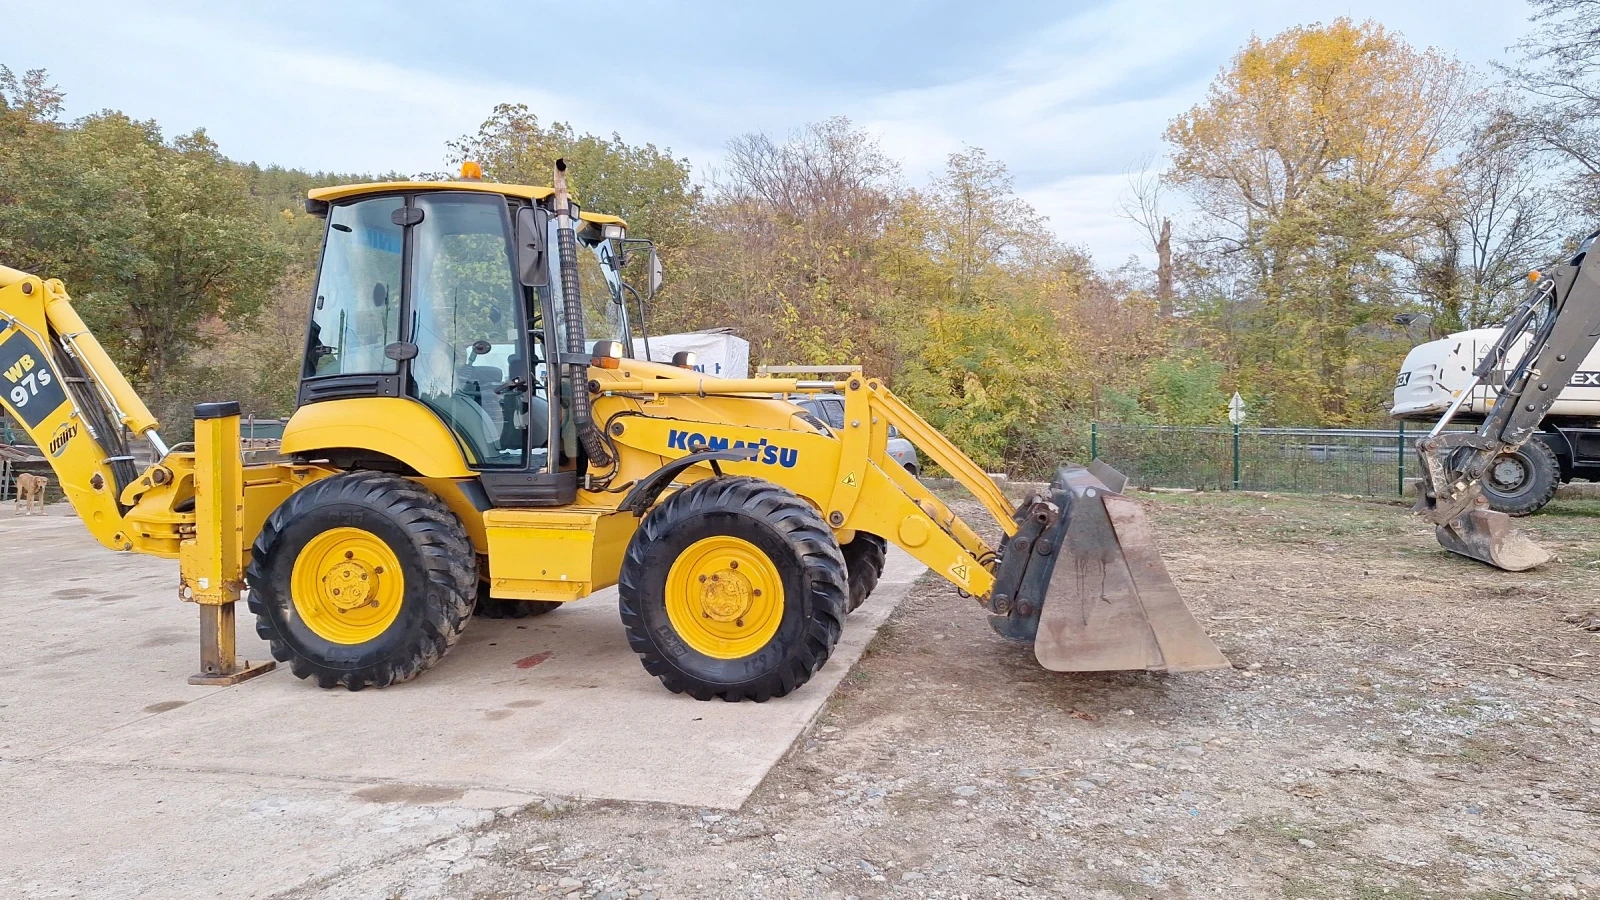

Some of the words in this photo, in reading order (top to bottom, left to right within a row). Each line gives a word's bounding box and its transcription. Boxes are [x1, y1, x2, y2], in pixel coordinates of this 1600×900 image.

[3, 354, 35, 384] WB
[49, 423, 78, 455] Utility
[667, 429, 798, 468] KOMATSU
[656, 624, 688, 657] BKT
